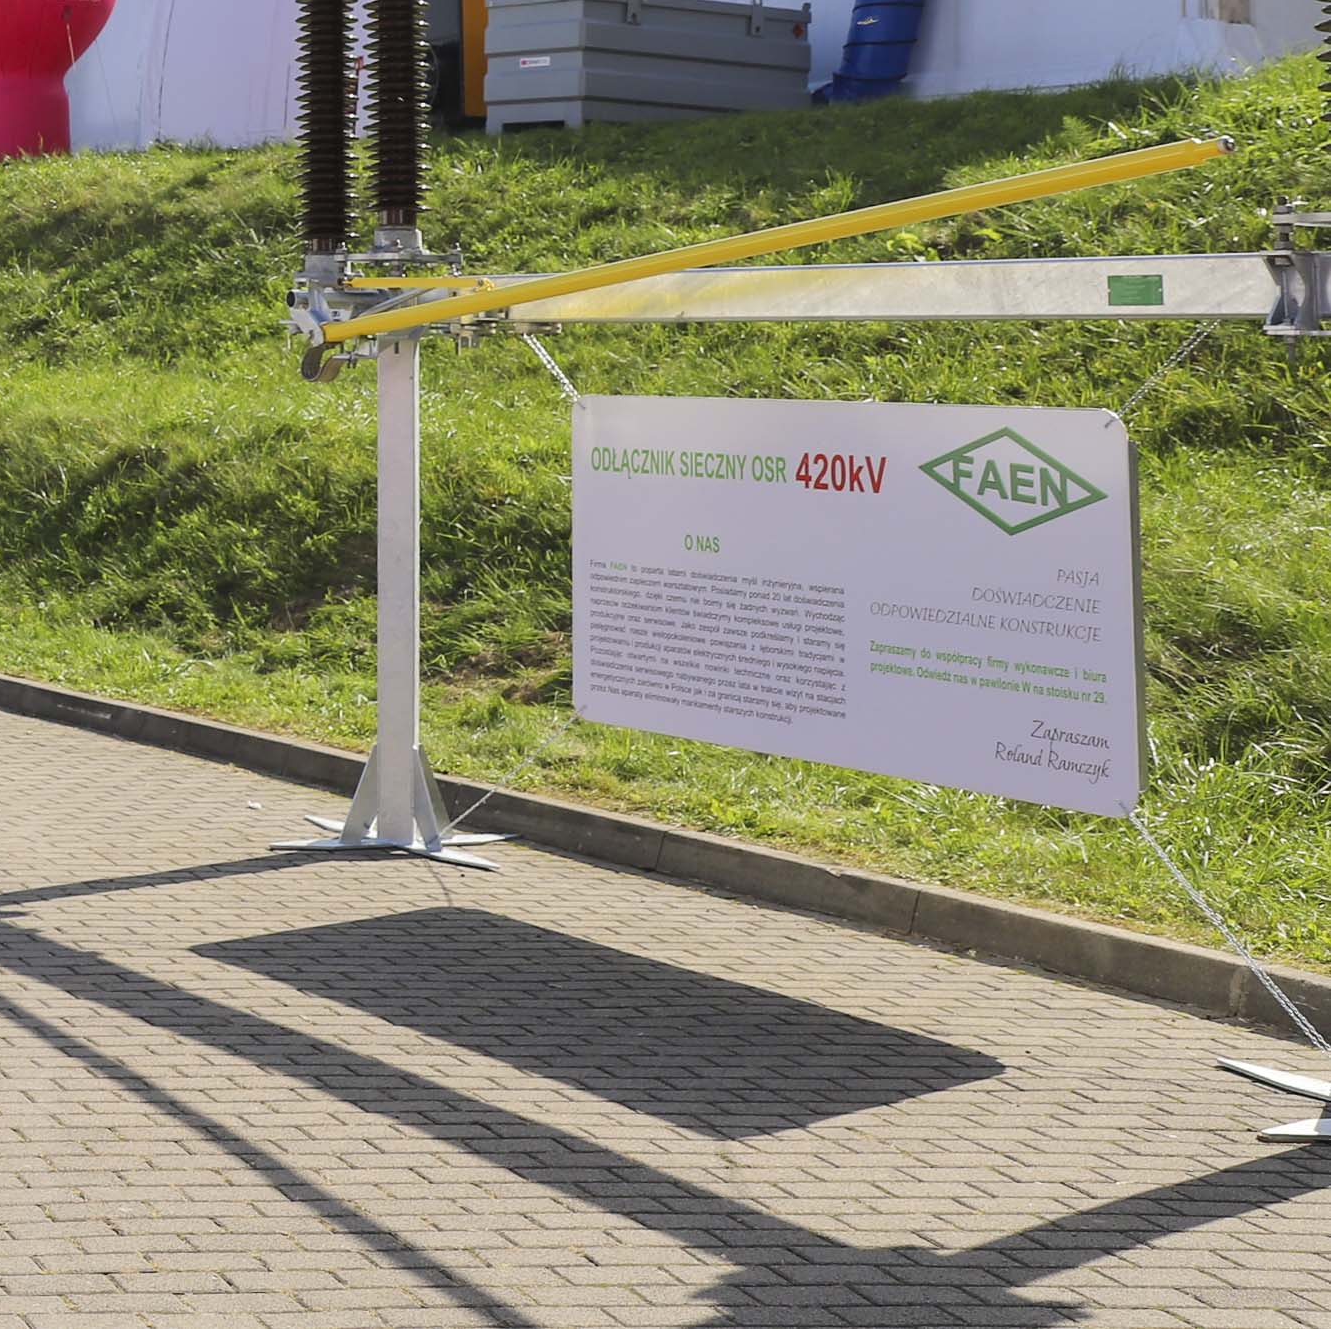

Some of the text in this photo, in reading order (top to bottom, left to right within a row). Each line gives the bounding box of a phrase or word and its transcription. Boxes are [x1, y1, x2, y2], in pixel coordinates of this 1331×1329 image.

[591, 447, 887, 493] ODŁĄCZNIK SIECZNY OSR 420kV
[953, 455, 1068, 507] FAEN
[684, 534, 720, 553] O NAS
[1056, 569, 1100, 588] PASJA
[971, 587, 1101, 614] DOŚWIADCZENIE
[870, 601, 1101, 643] ODPOWIEDZIALNE KONSTRUKCJE
[870, 640, 917, 659] Zapraszamy
[921, 647, 931, 659] do
[987, 656, 1009, 671] firmy
[1015, 661, 1069, 678] wykonawcze
[1083, 669, 1107, 683] biura
[953, 674, 968, 684] nas
[970, 677, 978, 685] w
[979, 677, 1019, 692] pawilonie
[1021, 682, 1032, 693] W
[1033, 685, 1044, 695] na
[1046, 686, 1079, 699] stoisku
[1081, 692, 1091, 701] nr
[1031, 720, 1110, 752] Zapraszam
[995, 741, 1111, 784] Roland Ramczyk
